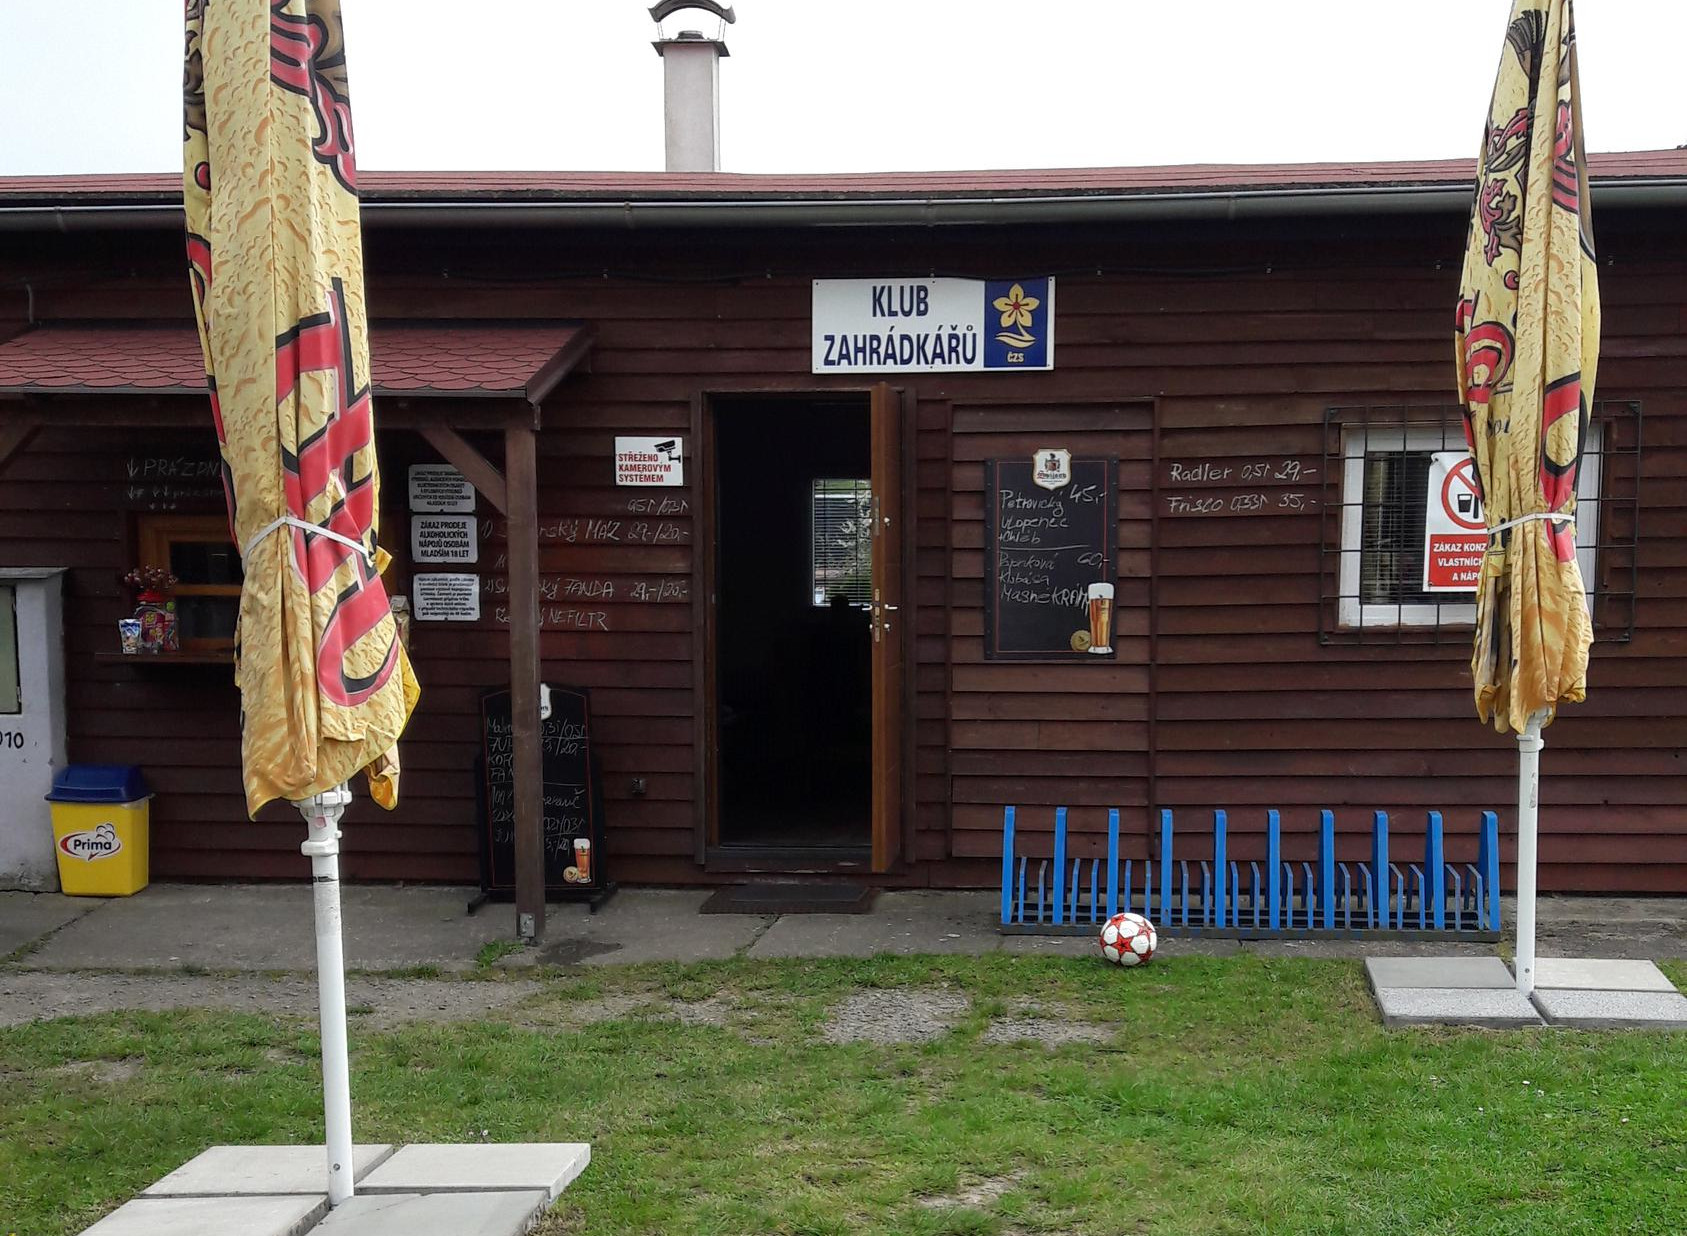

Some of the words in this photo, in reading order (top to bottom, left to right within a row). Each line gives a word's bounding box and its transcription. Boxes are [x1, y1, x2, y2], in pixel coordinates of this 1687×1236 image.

[872, 285, 929, 317] KLUB
[823, 324, 977, 366] ZAHRÁDKÁŘŮ
[1007, 352, 1024, 363] ČZS
[618, 451, 659, 462] STŘEŽENO
[618, 461, 671, 472] KAMEROVÝM
[1170, 463, 1232, 481] Radler
[1167, 495, 1224, 513] Frisco
[1433, 542, 1463, 551] ZÁKAZ
[1463, 543, 1487, 551] KONZ
[1452, 573, 1459, 581] A
[73, 838, 112, 850] Prima
